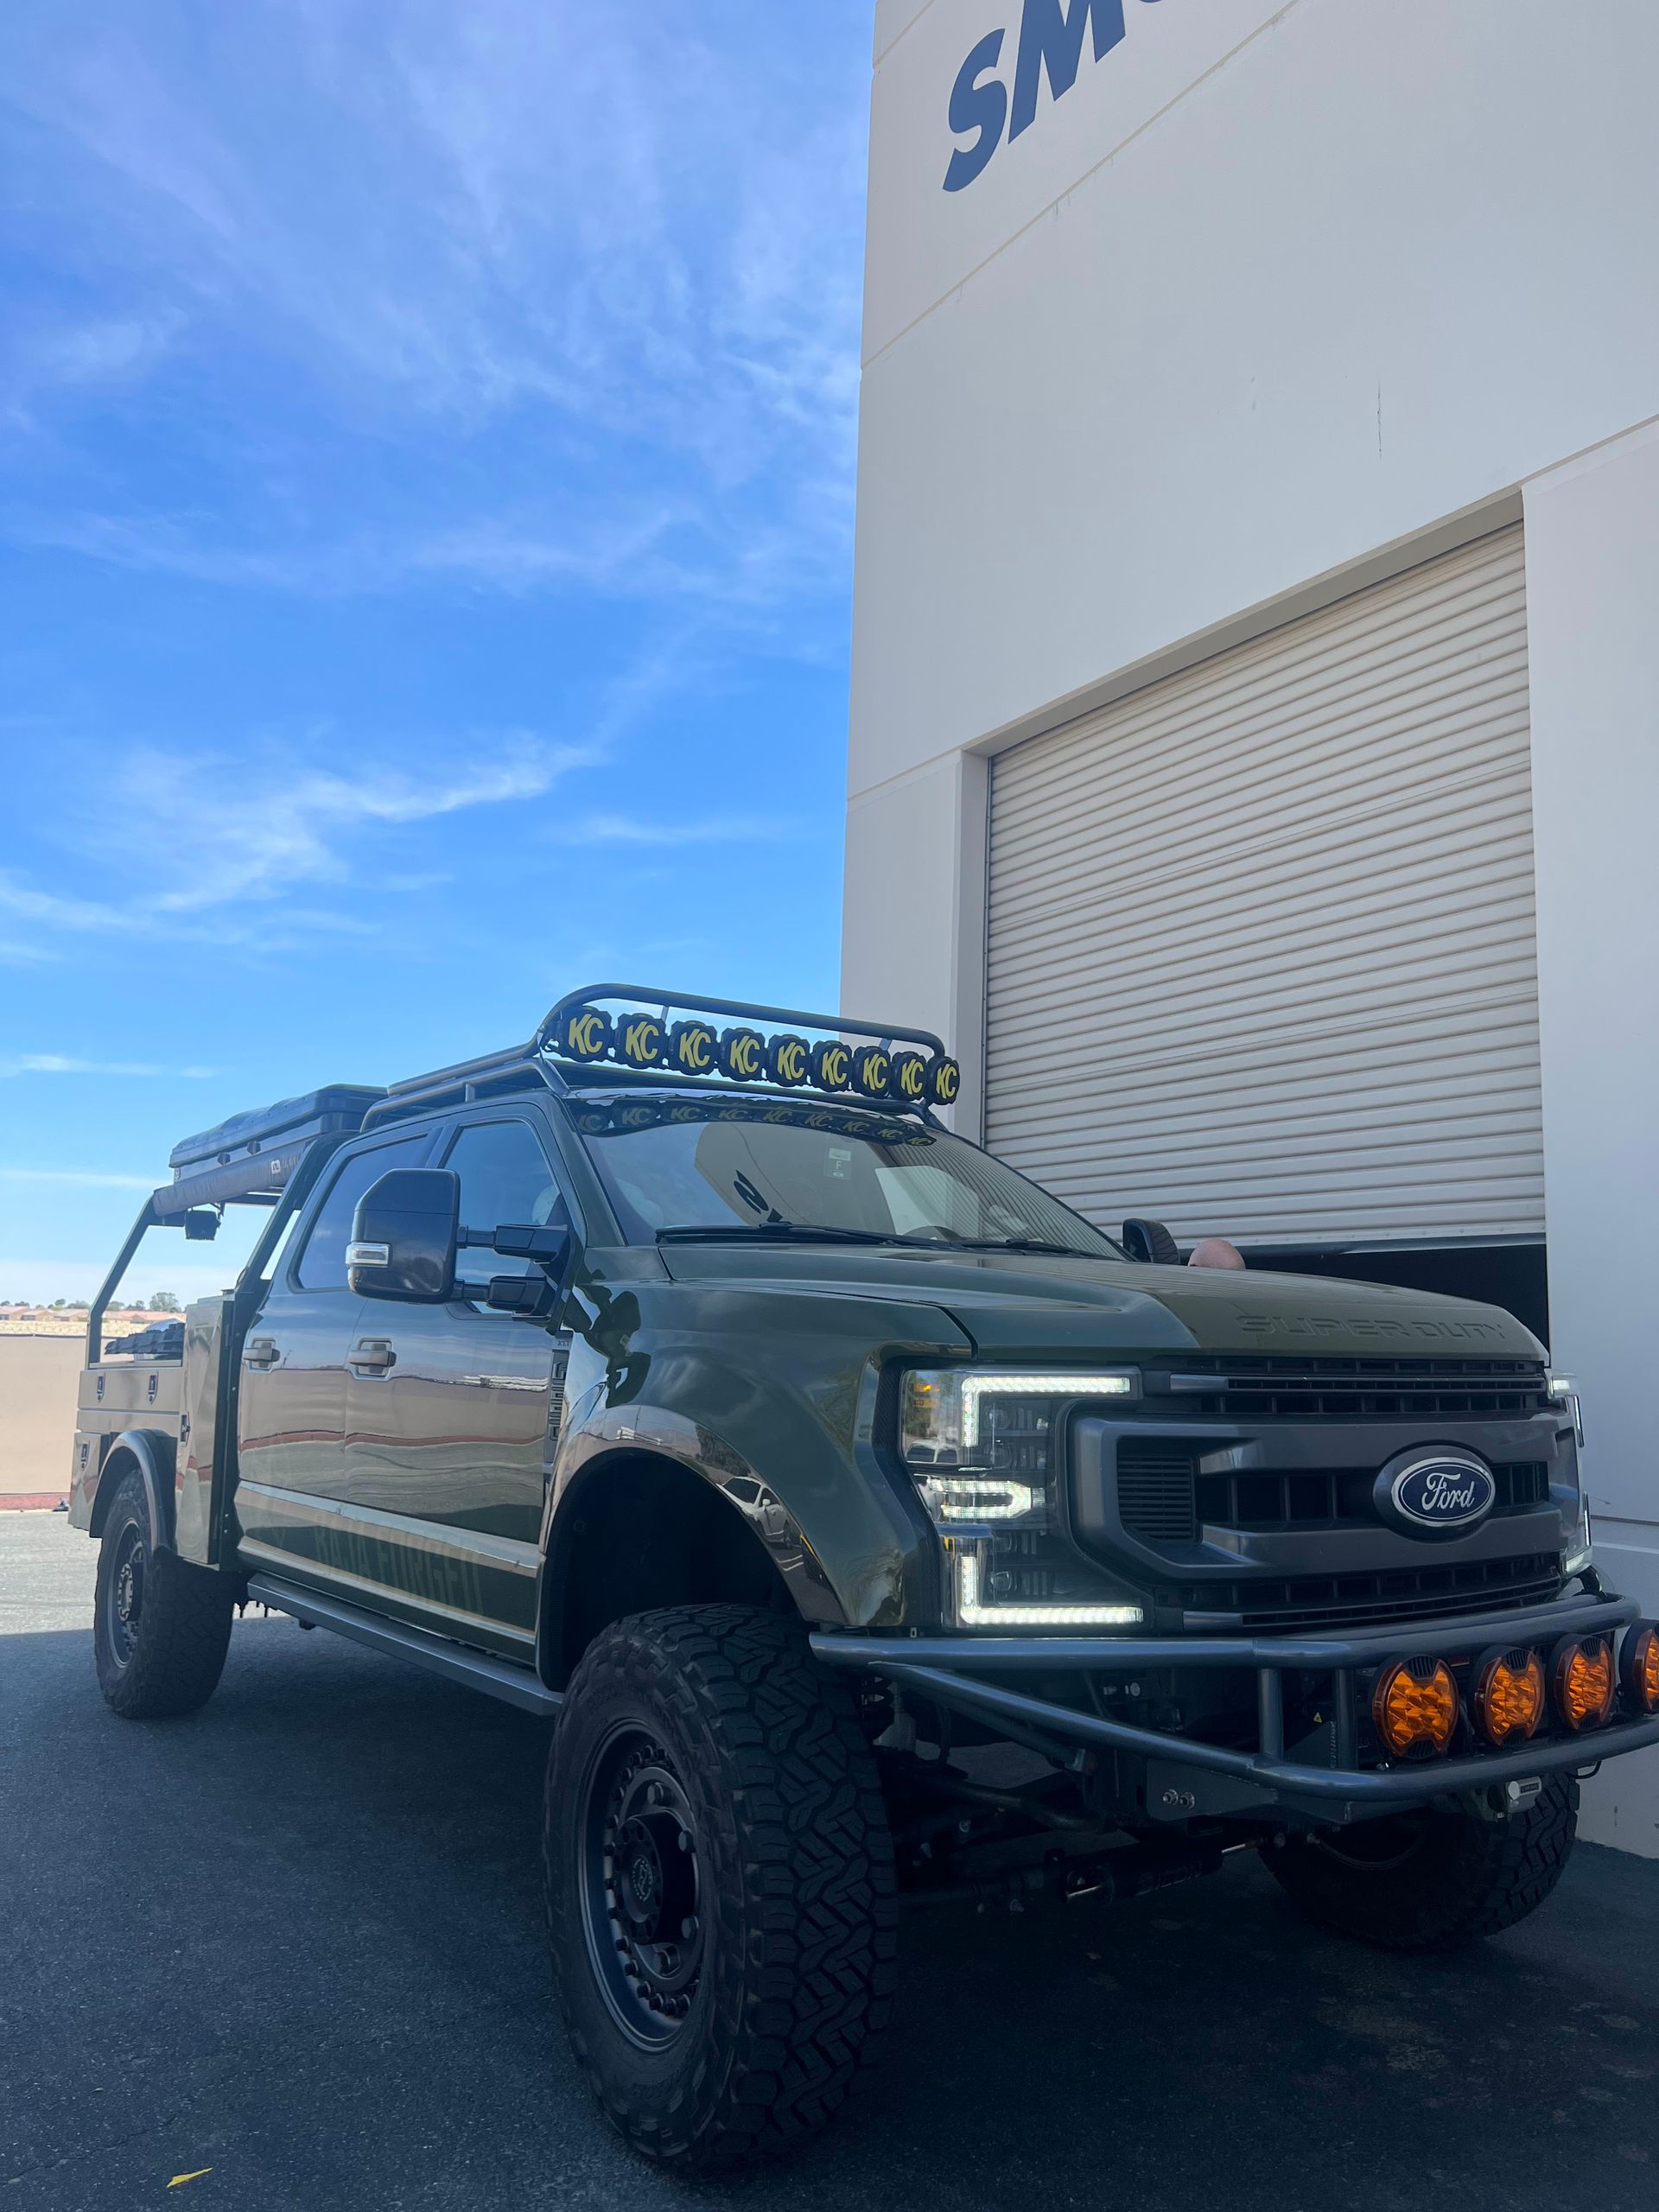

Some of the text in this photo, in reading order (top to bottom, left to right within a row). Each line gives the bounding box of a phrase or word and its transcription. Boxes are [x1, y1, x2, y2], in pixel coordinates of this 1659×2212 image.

[942, 0, 1163, 193] SM
[568, 1014, 605, 1055] KC
[625, 1021, 659, 1061] KC
[678, 1028, 711, 1069] KC
[729, 1036, 760, 1075] KC
[777, 1042, 805, 1080] KC
[822, 1047, 849, 1086] KC
[863, 1053, 888, 1090] KC
[900, 1058, 924, 1095] KC
[936, 1064, 957, 1099] KC
[1235, 1315, 1506, 1338] SUPER DUTY
[1421, 1472, 1475, 1510] Ford
